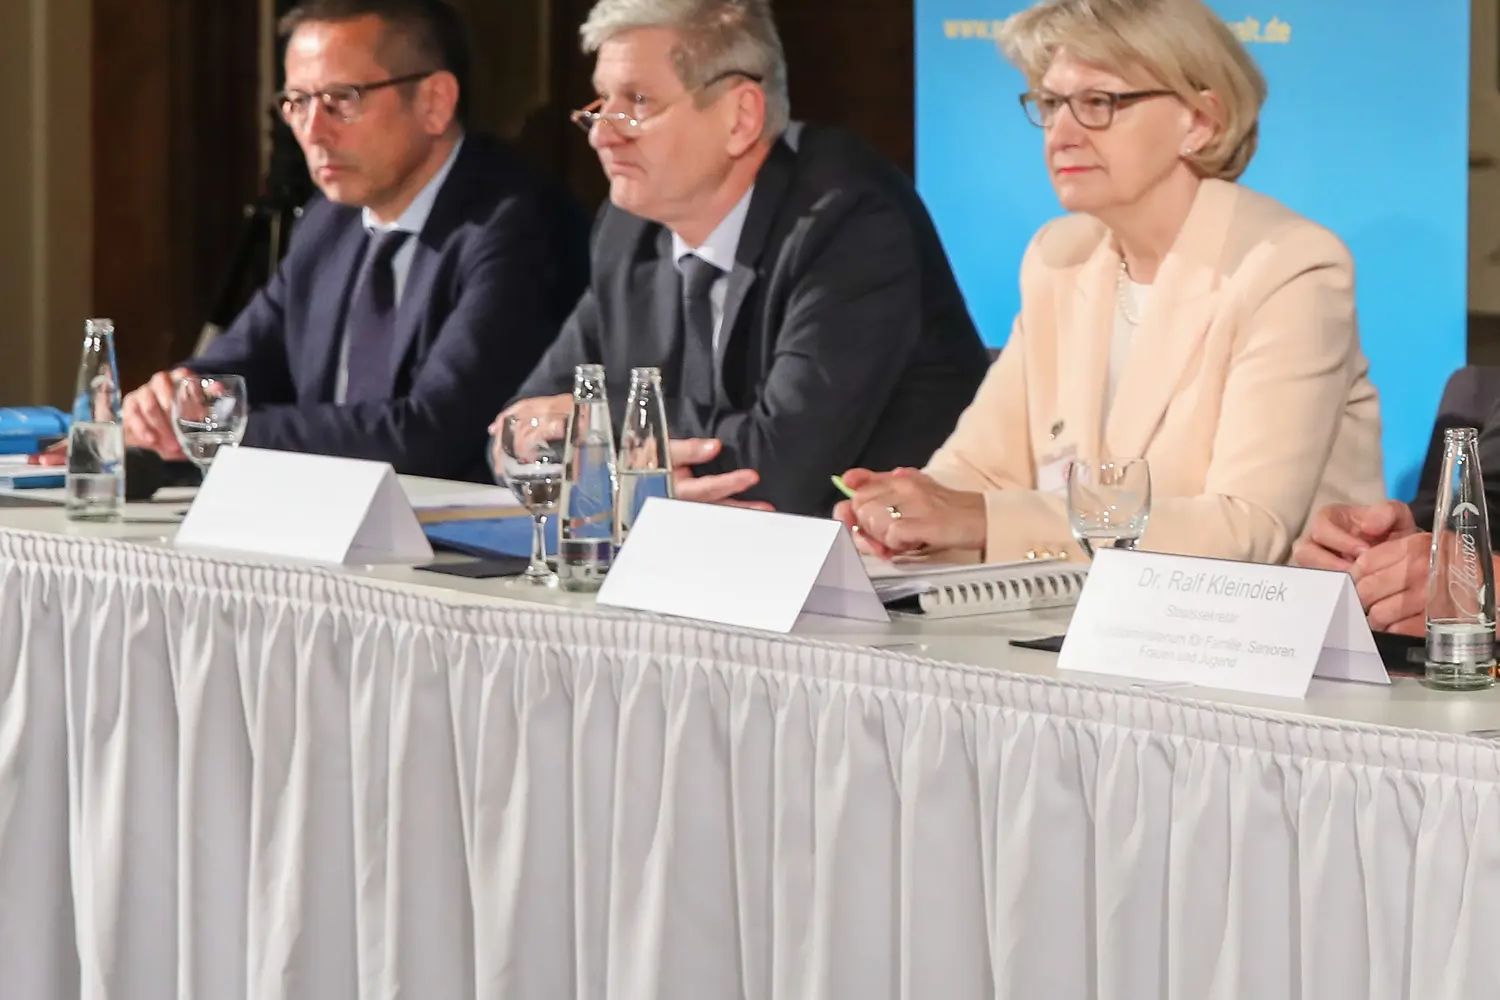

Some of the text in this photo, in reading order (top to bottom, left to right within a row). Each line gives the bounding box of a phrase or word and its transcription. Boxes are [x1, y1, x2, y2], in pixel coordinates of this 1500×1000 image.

[1137, 567, 1288, 601] Dr. Ralf Kleindiek
